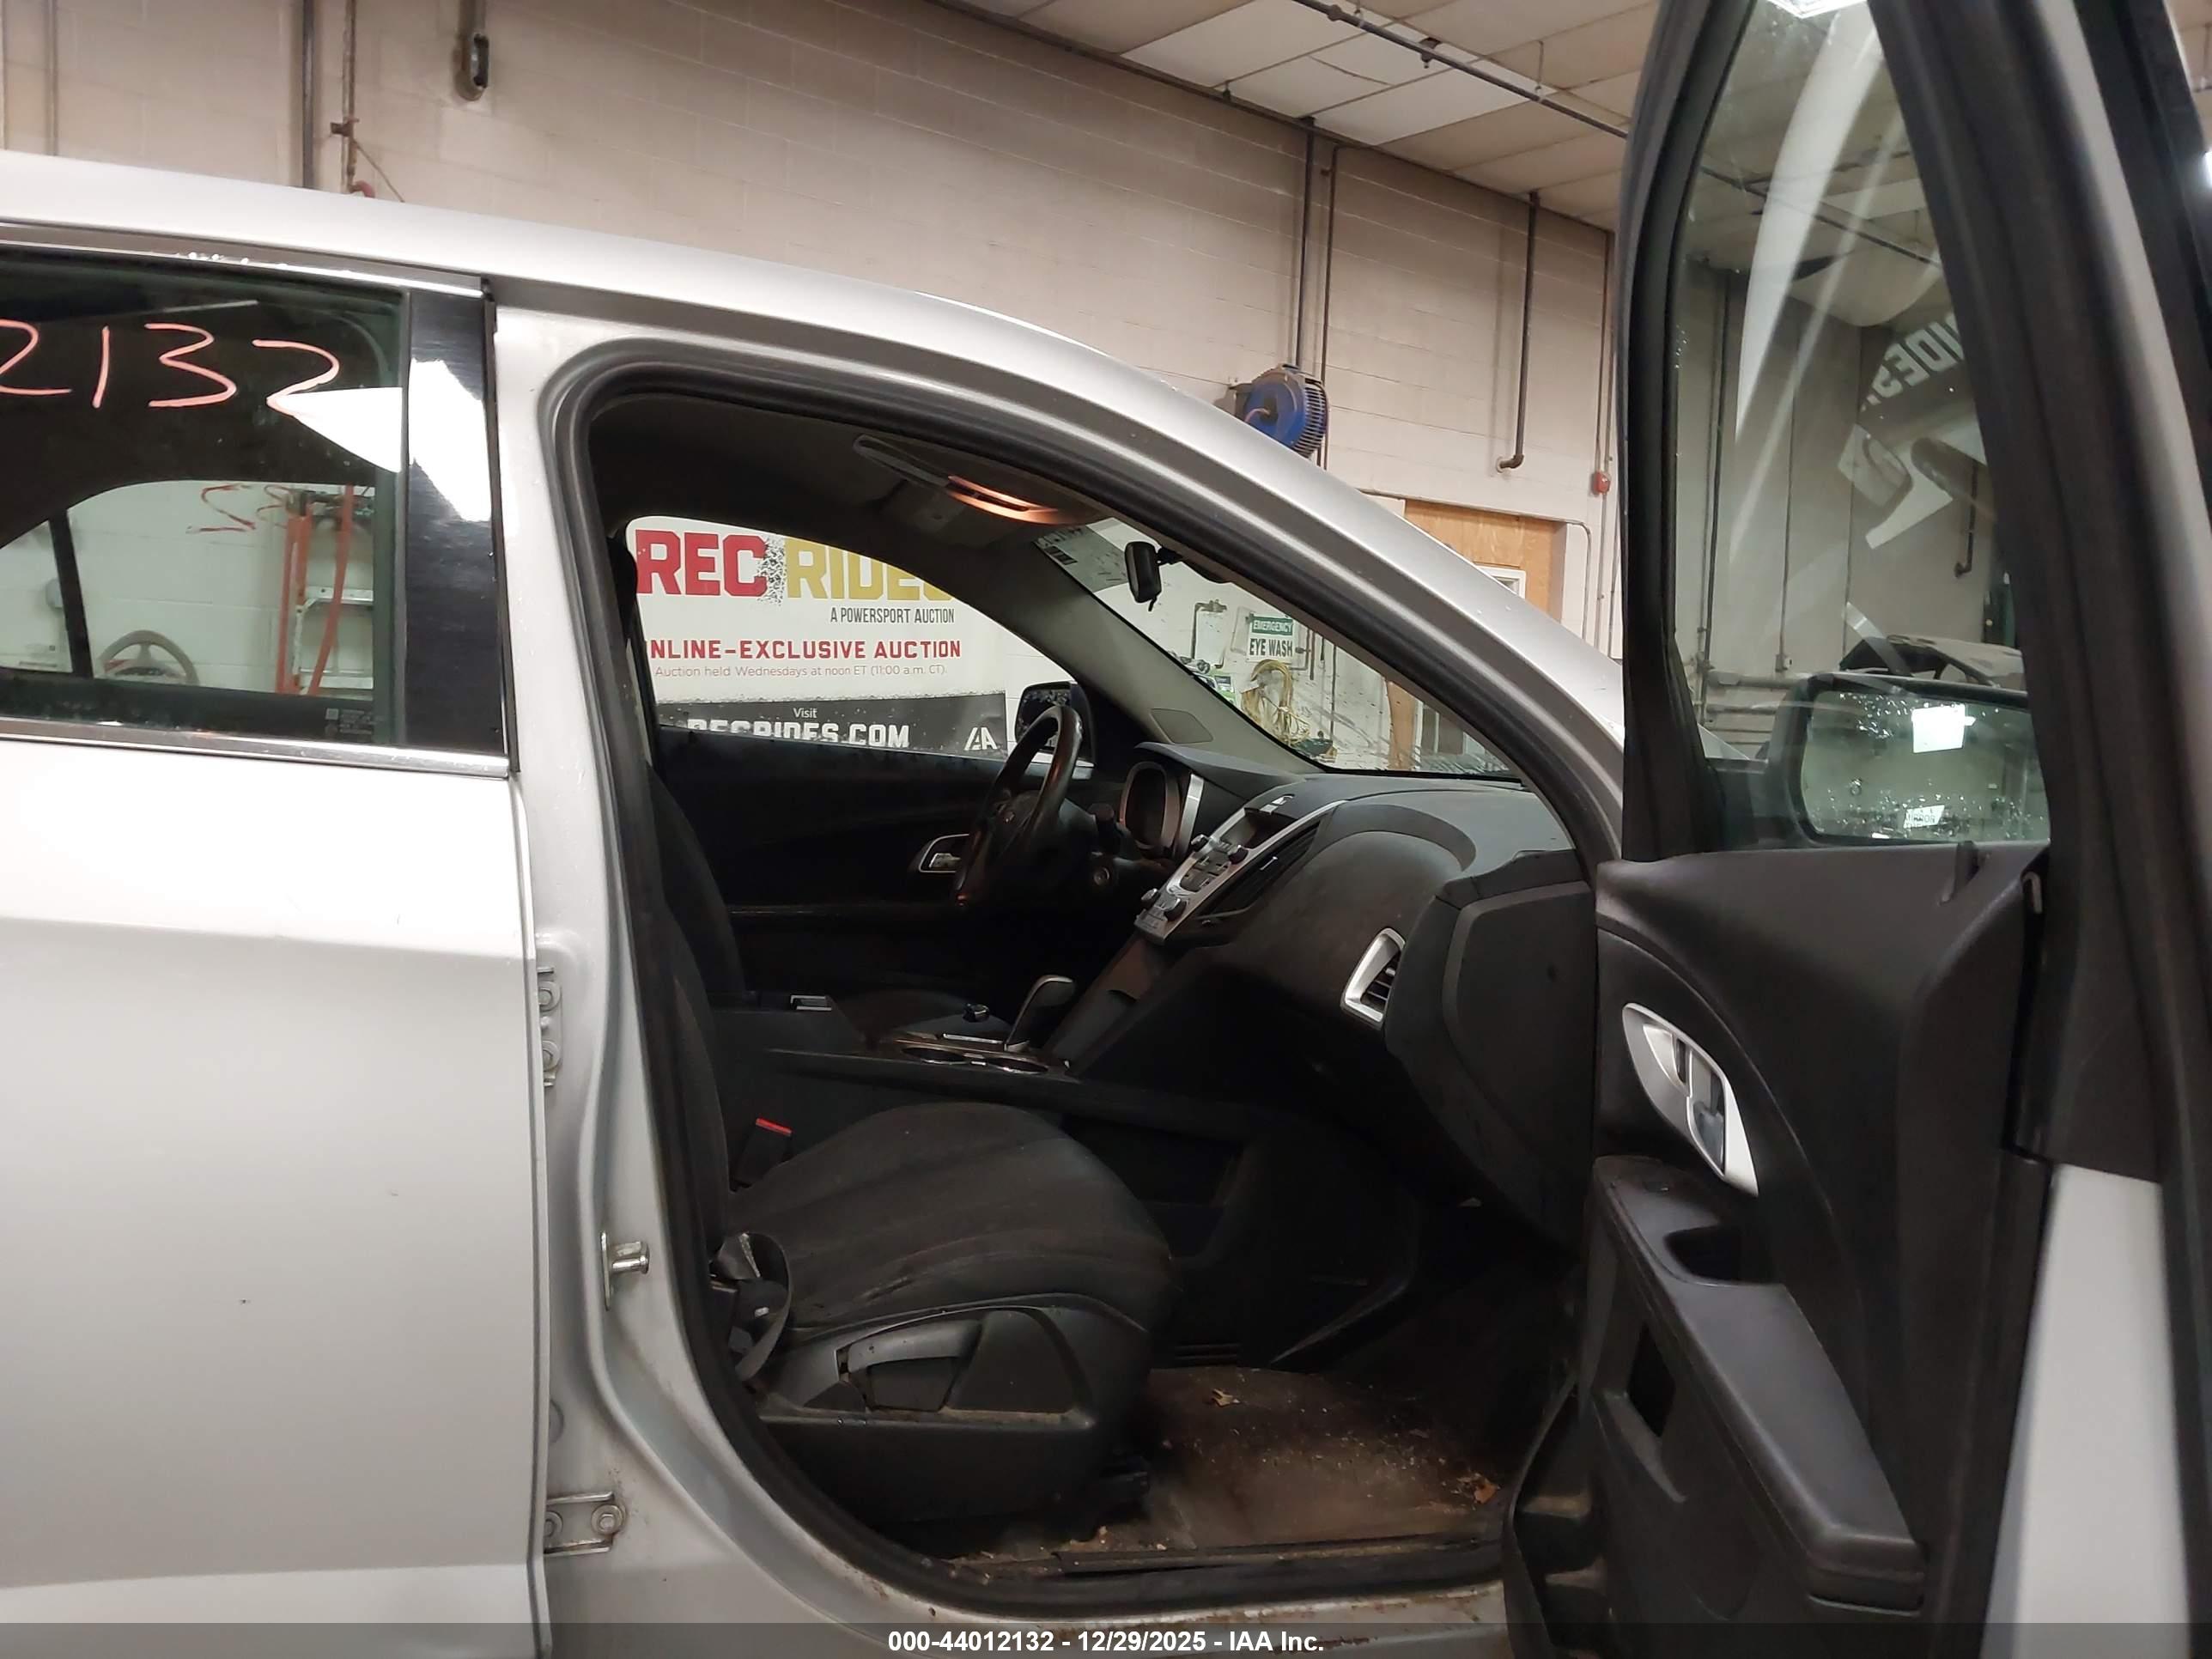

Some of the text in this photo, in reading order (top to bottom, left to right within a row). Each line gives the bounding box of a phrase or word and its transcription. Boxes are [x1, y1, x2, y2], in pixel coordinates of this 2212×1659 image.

[635, 529, 954, 601] REC RIDE
[830, 606, 955, 623] A POWERSPORT AUCTION
[1253, 619, 1293, 633] EMERGENCY
[646, 640, 961, 659] NLINE-EXCLUSIVE AUCTION
[1249, 638, 1293, 658] EYE WASH
[655, 666, 701, 678] Auction
[704, 666, 731, 677] held
[735, 666, 807, 678] Wednesdays
[811, 666, 822, 676] at
[824, 667, 851, 677] noon
[854, 665, 866, 676] ET
[871, 665, 901, 677] (11:00
[903, 666, 926, 676] a.m.
[793, 708, 817, 719] Visit
